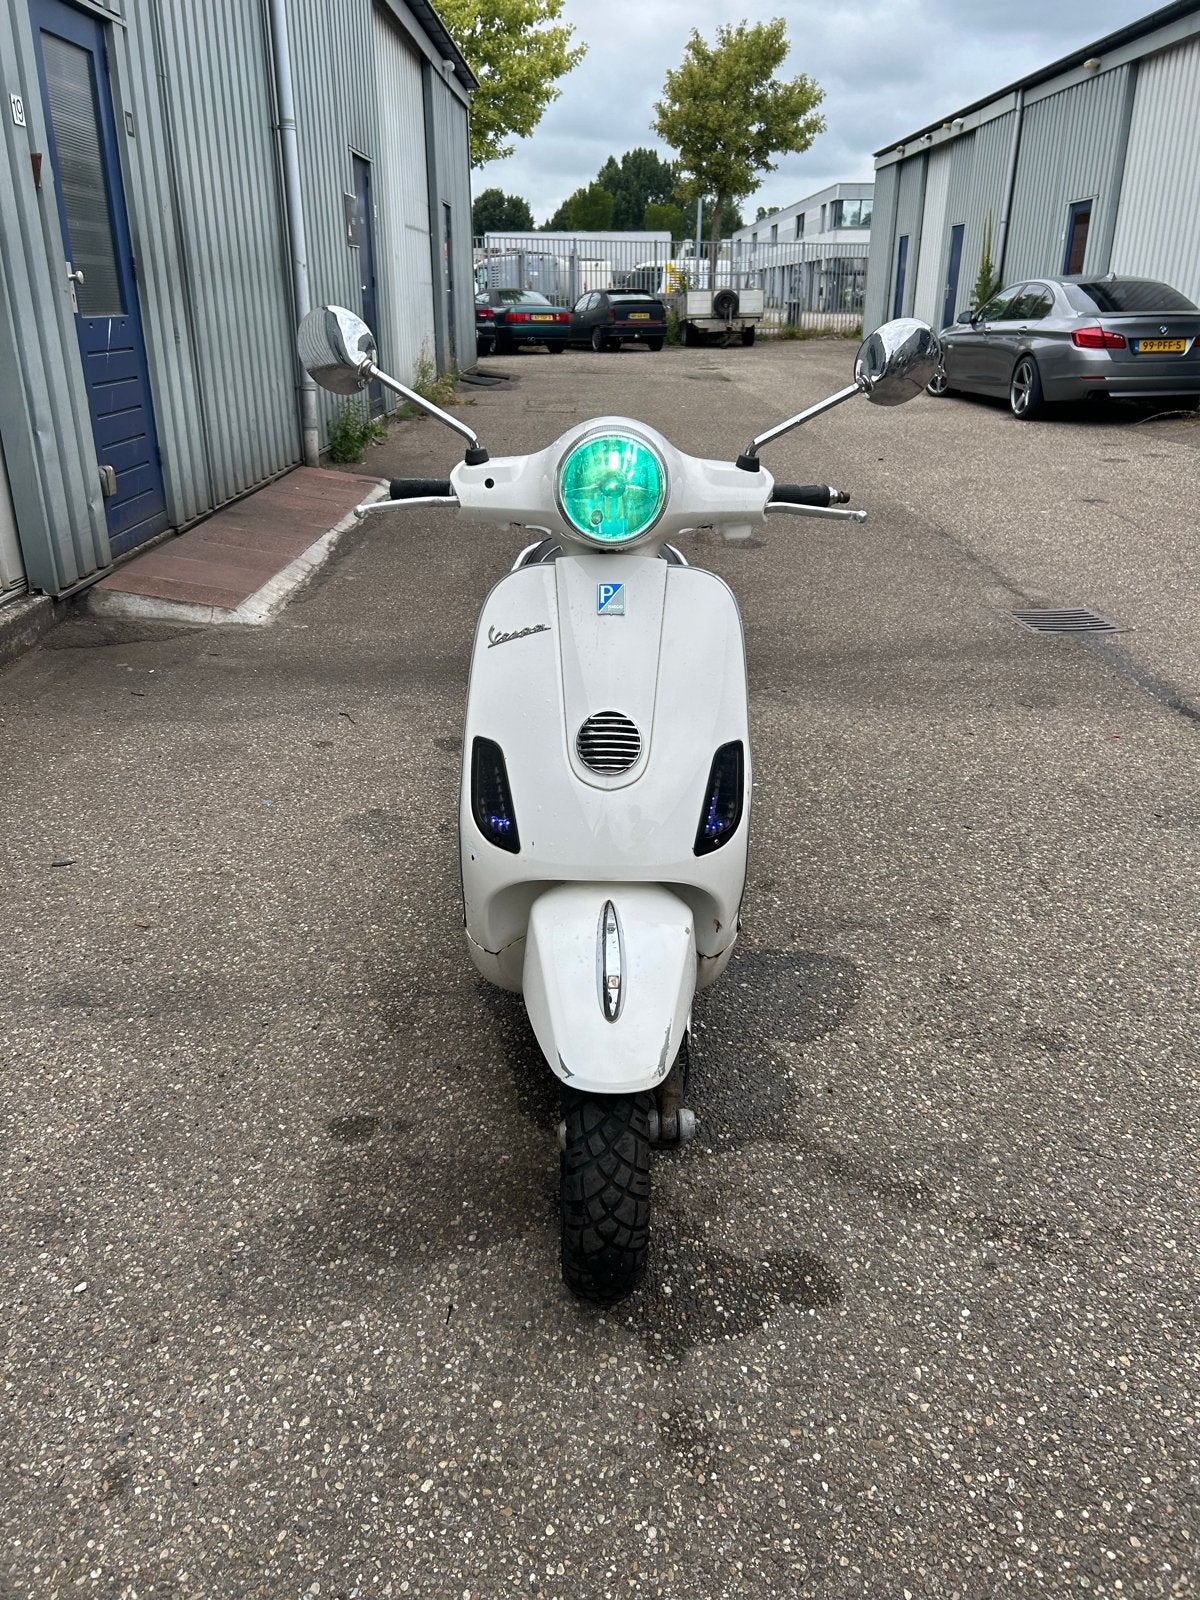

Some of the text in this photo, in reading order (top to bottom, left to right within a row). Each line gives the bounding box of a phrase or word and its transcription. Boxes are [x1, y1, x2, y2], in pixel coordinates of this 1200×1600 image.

[12, 98, 24, 123] 19
[1142, 341, 1182, 350] 99-PFF-5
[600, 585, 614, 604] P
[487, 624, 551, 648] Vespa
